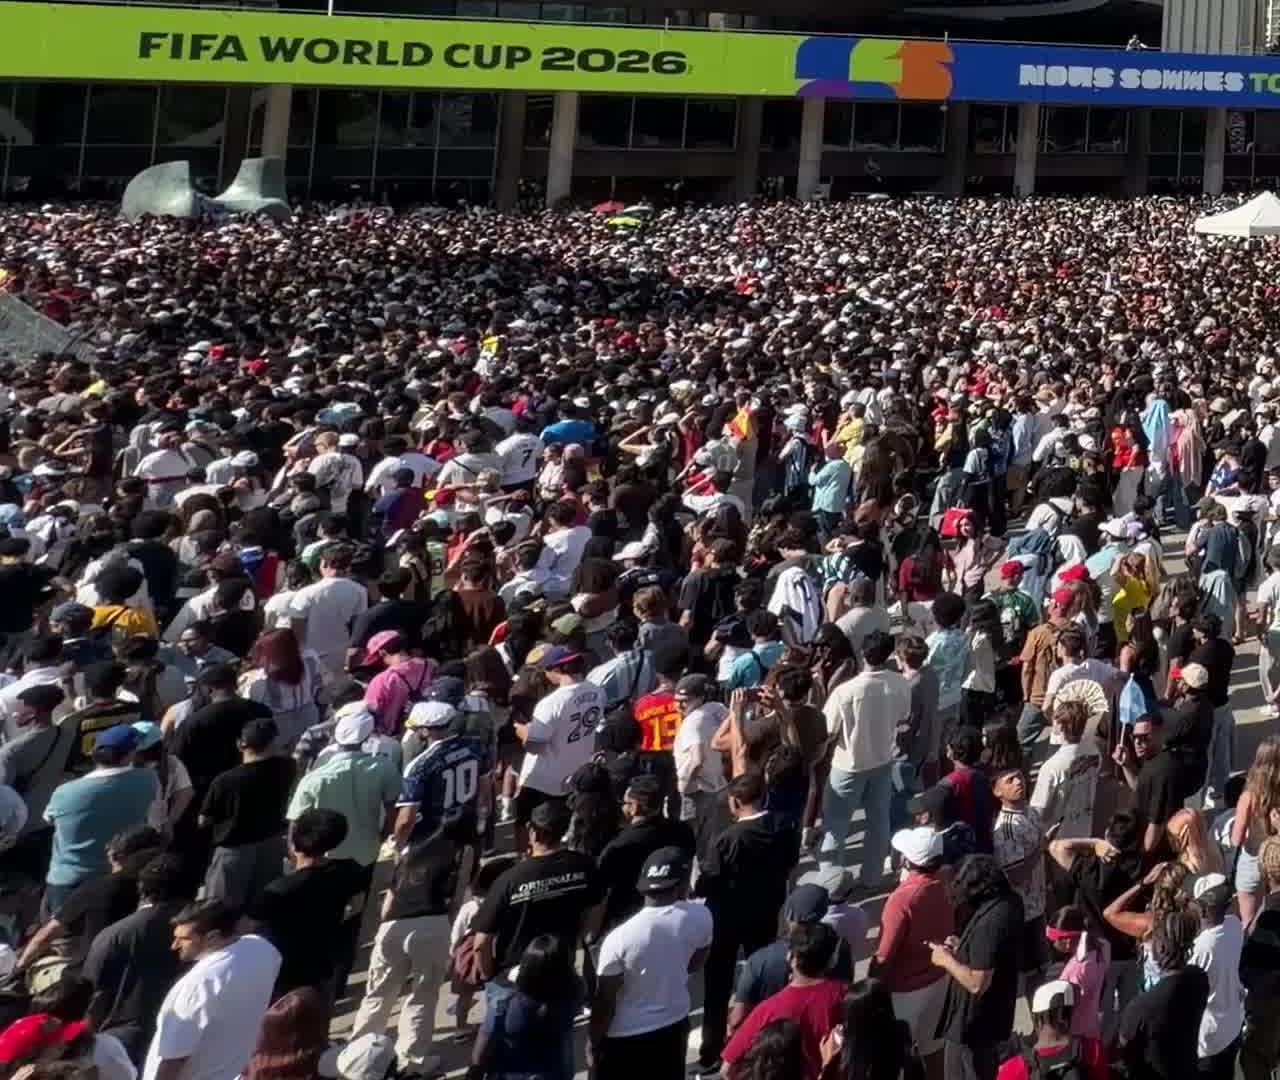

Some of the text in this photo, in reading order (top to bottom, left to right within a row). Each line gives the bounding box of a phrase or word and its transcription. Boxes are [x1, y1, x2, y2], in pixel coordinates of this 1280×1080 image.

[138, 31, 688, 74] FIFA WORLD CUP 2026
[1019, 64, 1114, 88] NOUS
[1119, 68, 1245, 92] SOMMES
[567, 706, 601, 744] 29
[442, 758, 478, 810] 10
